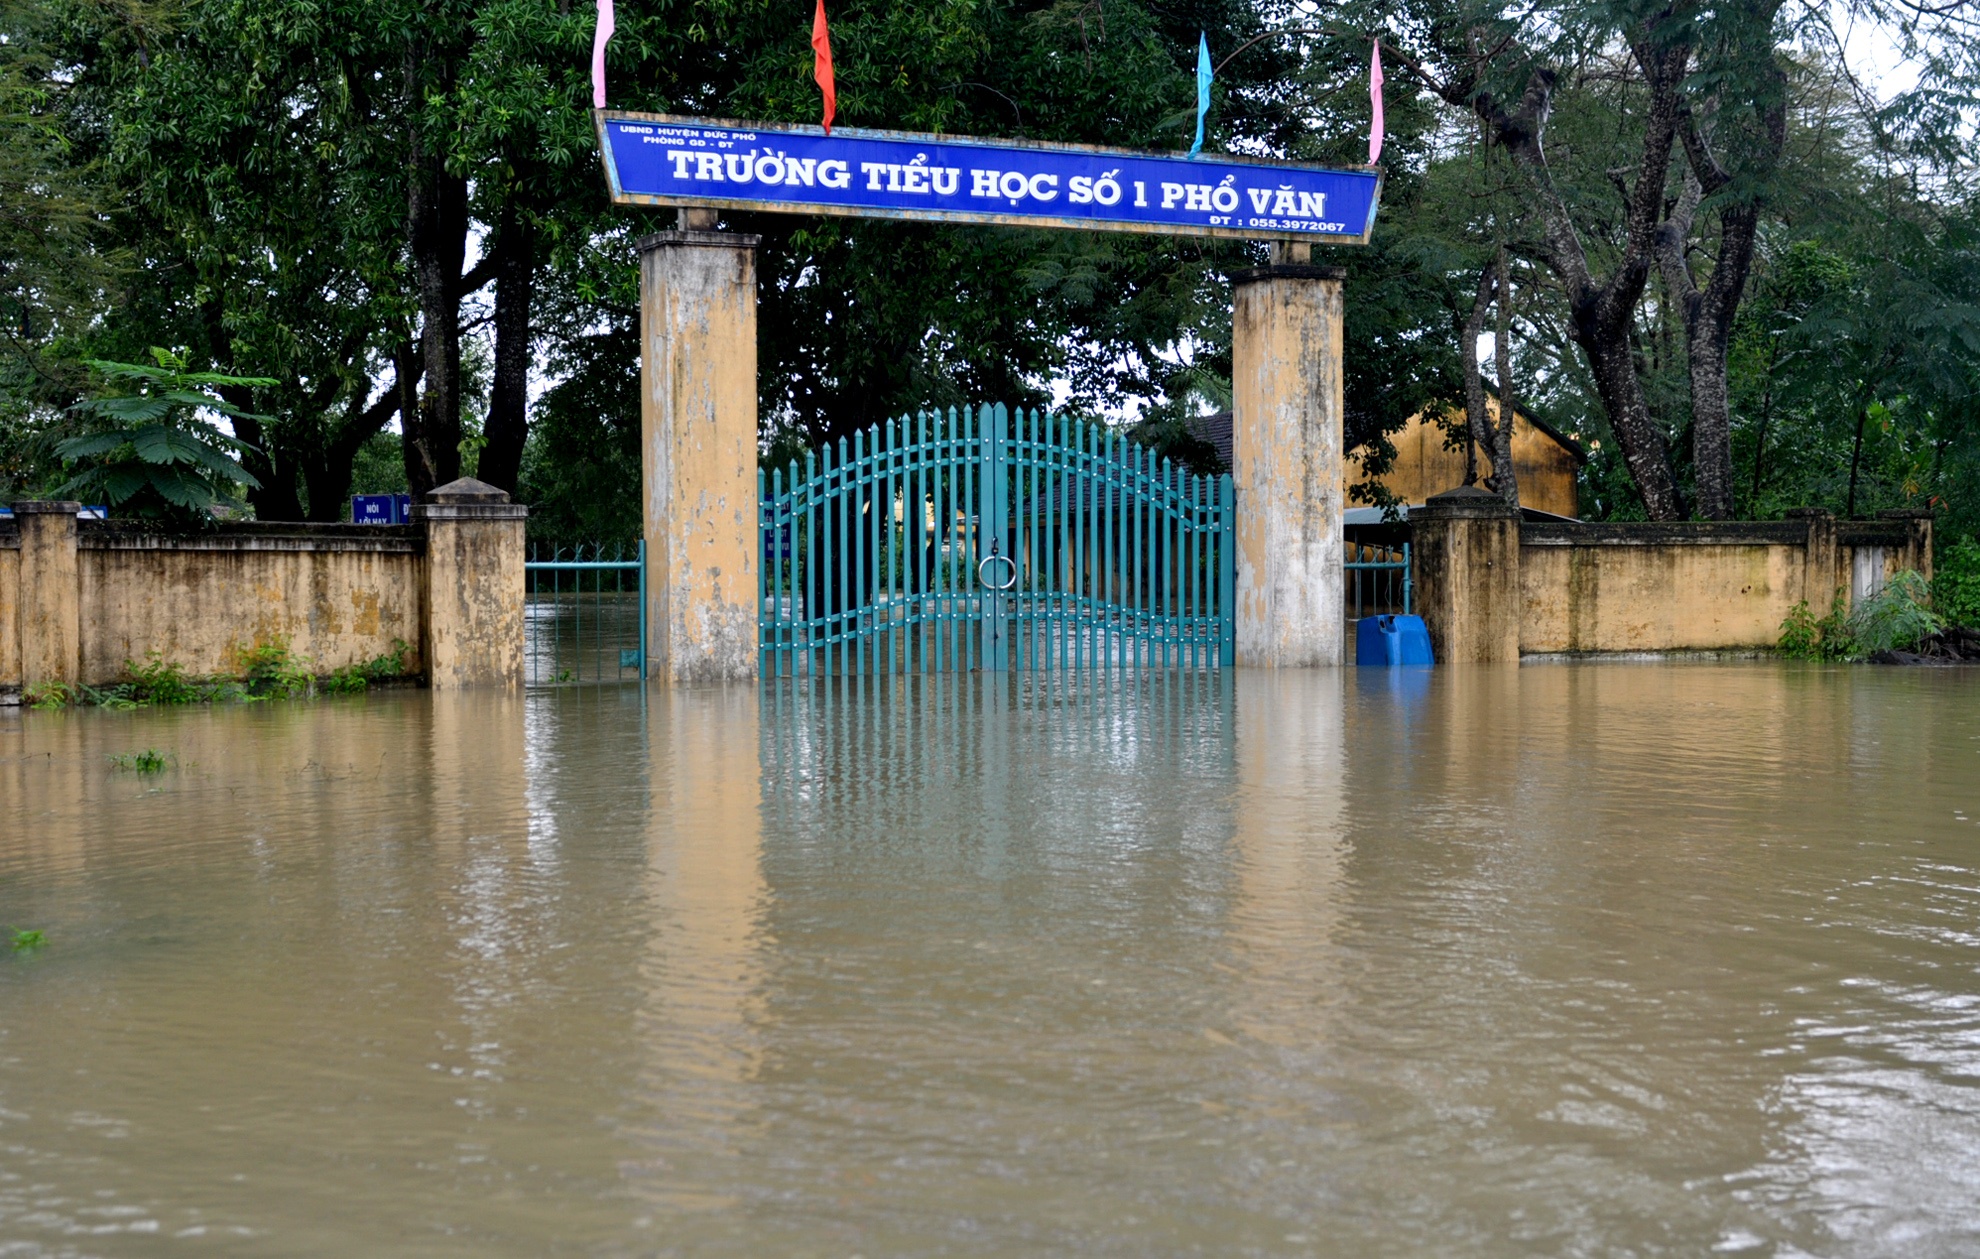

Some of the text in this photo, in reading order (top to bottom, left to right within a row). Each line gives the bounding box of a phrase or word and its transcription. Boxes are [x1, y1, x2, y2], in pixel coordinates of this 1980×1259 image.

[620, 125, 653, 134] UBND
[658, 127, 699, 138] HUYỆN
[643, 136, 685, 146] PHÒNG
[689, 139, 706, 147] GD
[667, 147, 1327, 218] TRƯỜNG TIỂU HỌC SỐ 1 PHỔ VĂN
[1209, 215, 1231, 225] ĐT
[1249, 218, 1346, 232] 055.3972067
[366, 502, 379, 513] NÓI
